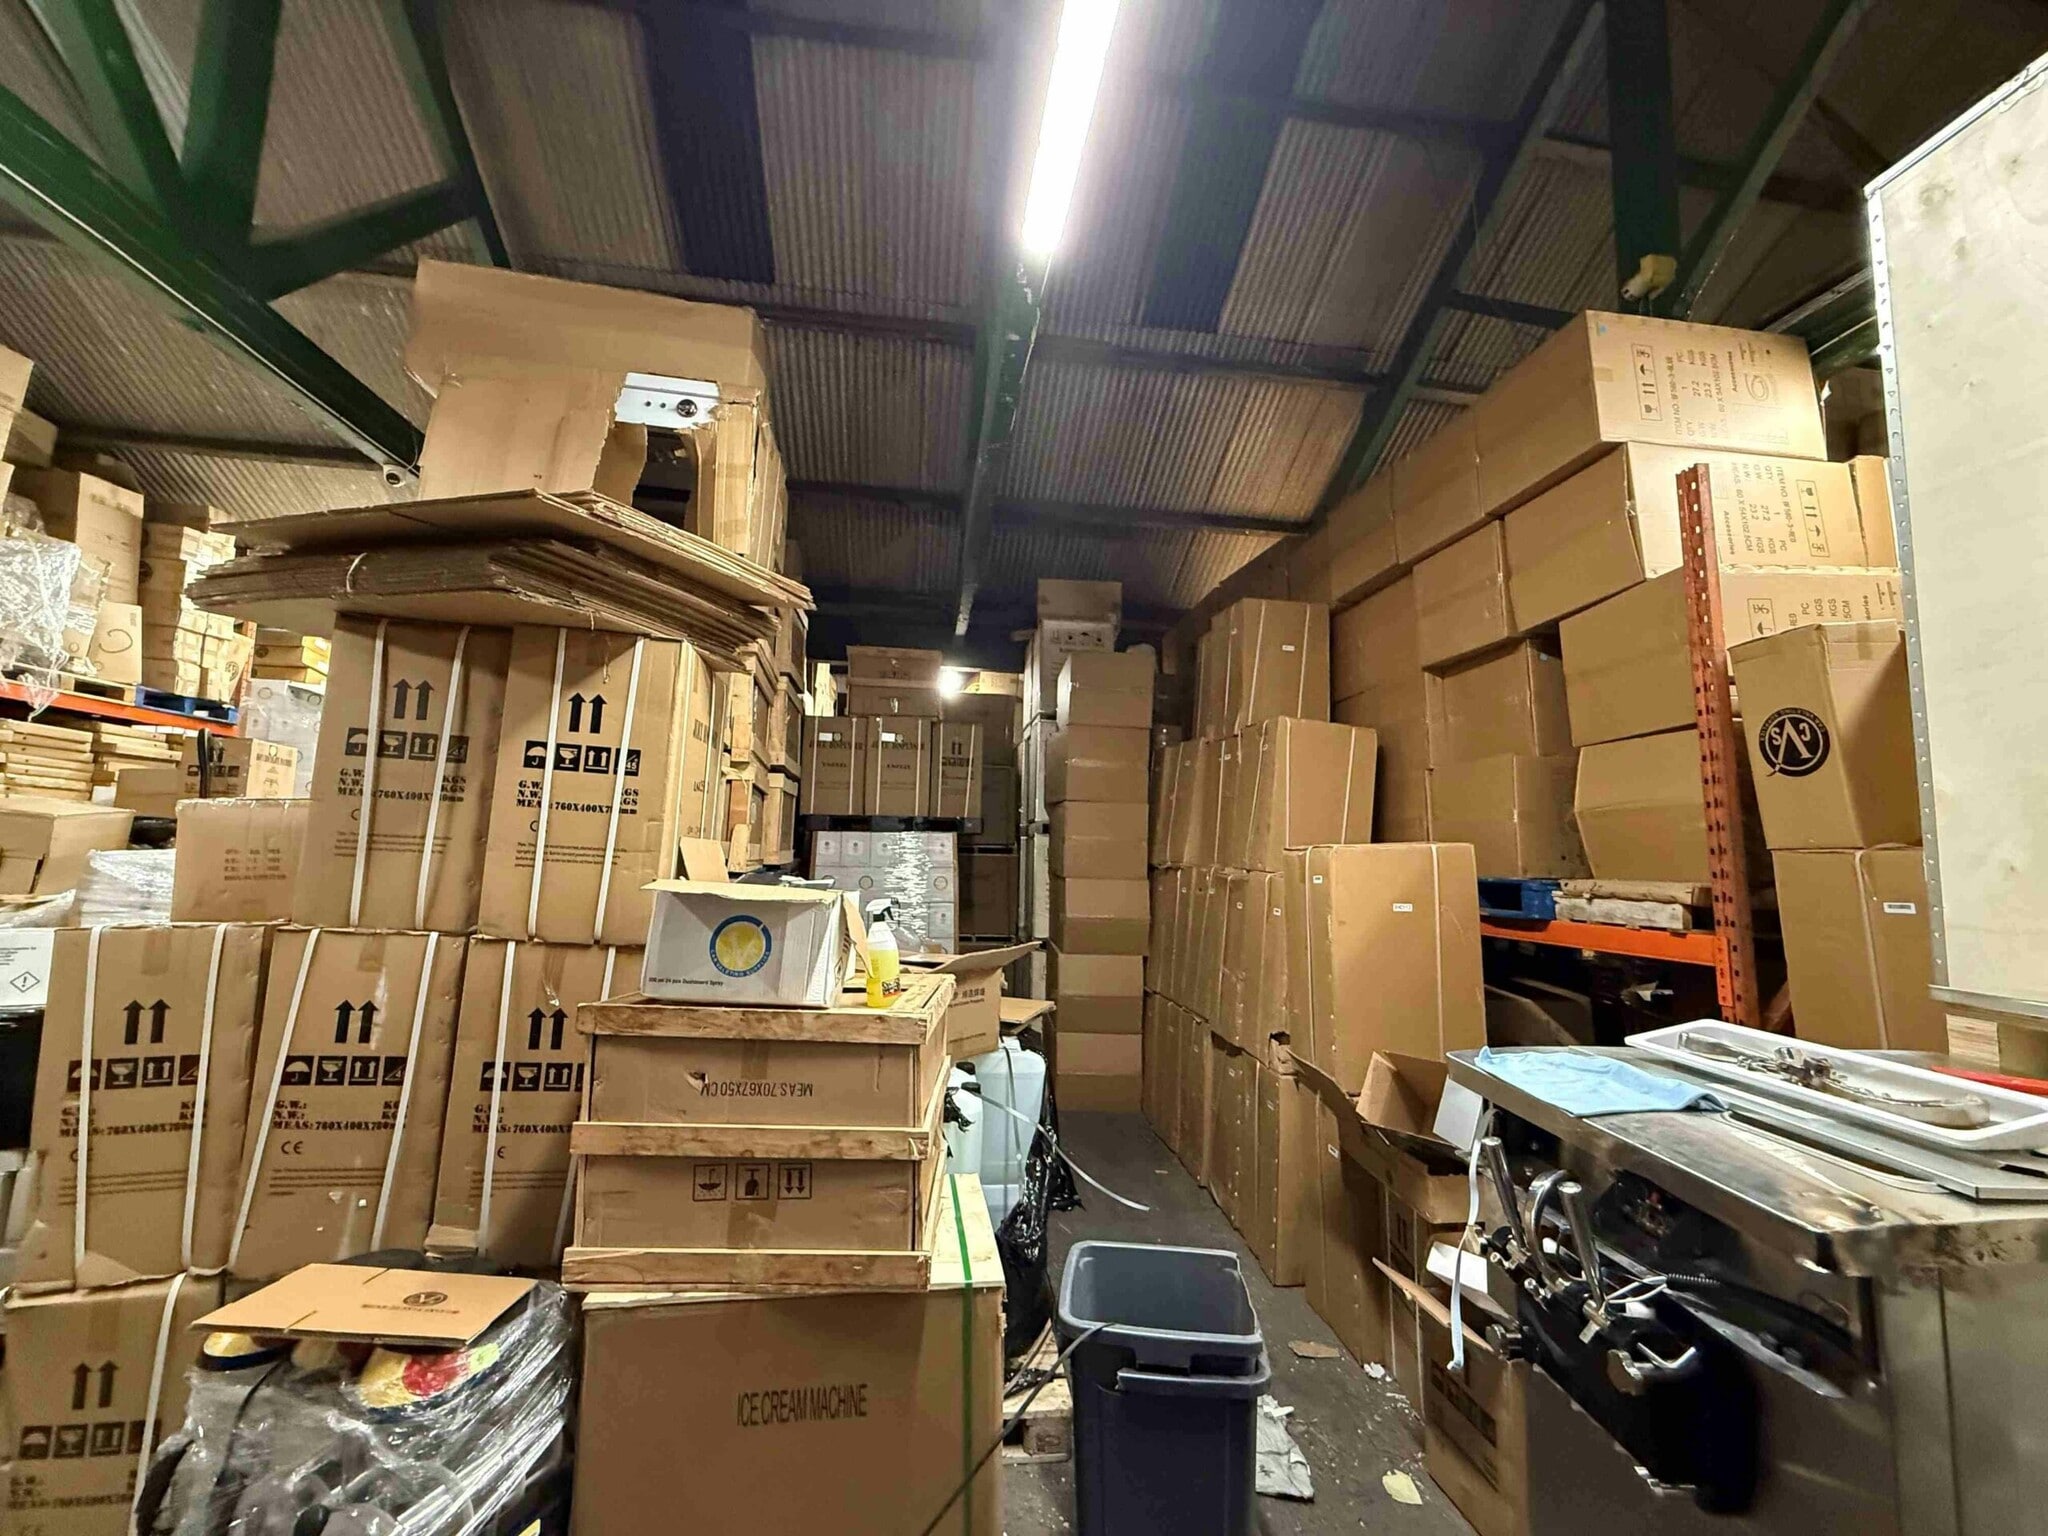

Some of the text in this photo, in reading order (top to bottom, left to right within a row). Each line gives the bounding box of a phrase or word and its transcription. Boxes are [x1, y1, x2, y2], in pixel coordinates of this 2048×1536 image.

[1724, 510, 1735, 555] Accessories
[1760, 504, 1770, 522] 27.2
[1768, 538, 1776, 554] KGS
[1755, 536, 1765, 554] KGS
[1780, 540, 1788, 552] PC
[1801, 602, 1810, 615] PC
[1814, 598, 1824, 616] KGS
[1828, 598, 1837, 616] KGS
[1788, 613, 1798, 626] RED
[736, 1384, 868, 1427] ICE CREAM MACHINE
